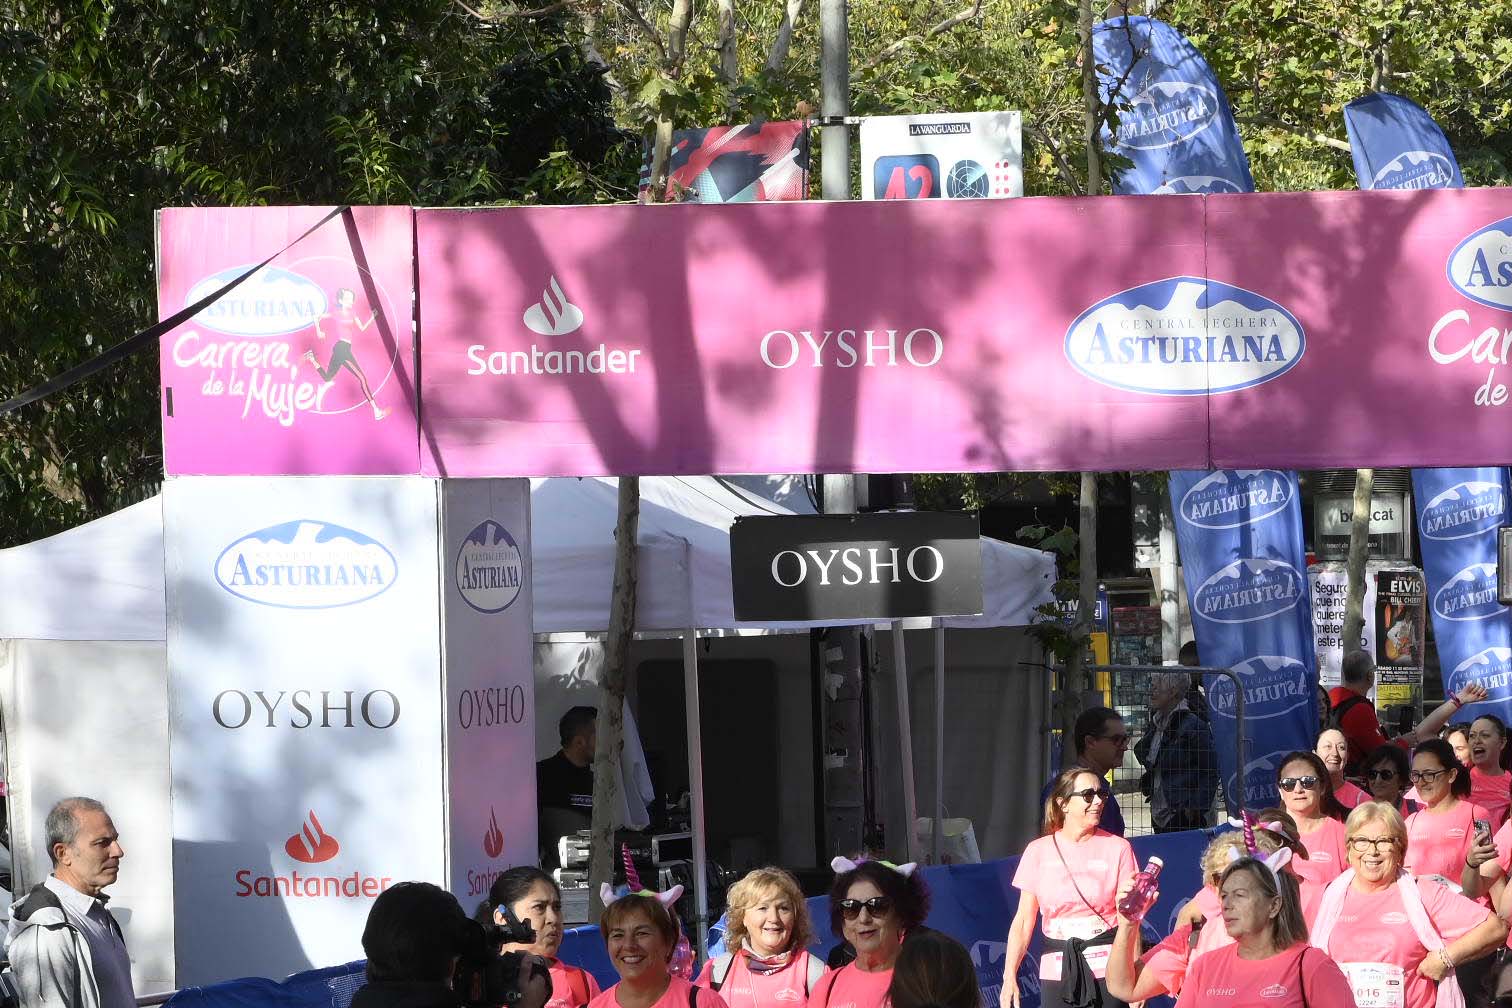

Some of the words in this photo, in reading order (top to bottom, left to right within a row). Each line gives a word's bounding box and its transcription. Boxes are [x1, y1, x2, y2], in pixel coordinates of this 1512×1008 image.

[921, 123, 970, 135] VANGUARDIA
[1119, 318, 1196, 331] CENTRAL
[1202, 316, 1280, 330] LECHERA
[172, 330, 291, 369] Carrera
[466, 343, 641, 376] Santander
[759, 328, 945, 369] OYSHO
[1085, 321, 1288, 366] ASTURIANA
[202, 370, 225, 396] de
[229, 370, 245, 396] la
[241, 365, 336, 428] Mujer
[1473, 368, 1509, 407] de
[228, 552, 385, 587] ASTURIANA
[461, 556, 519, 590] ASTURIANA
[771, 544, 945, 588] OYSHO
[1316, 597, 1333, 608] que
[1390, 580, 1421, 593] ELVIS
[1317, 636, 1336, 647] este
[212, 689, 401, 730] OYSHO
[458, 684, 525, 729] OYSHO
[235, 869, 392, 898] Santander
